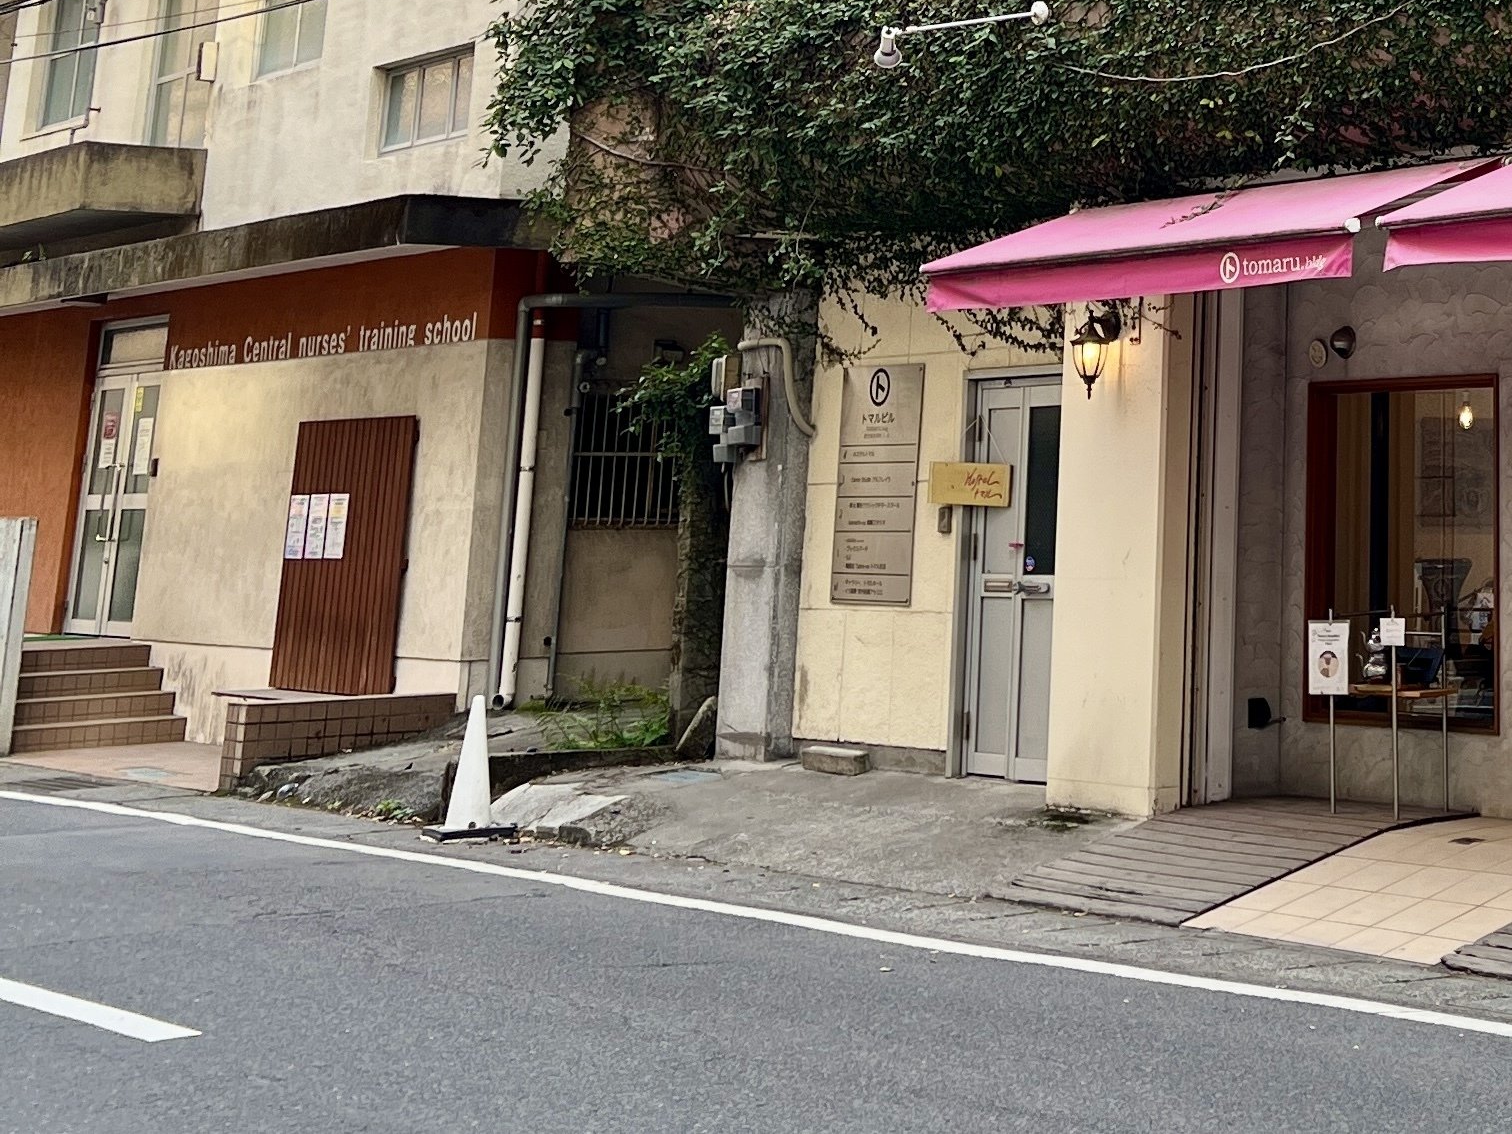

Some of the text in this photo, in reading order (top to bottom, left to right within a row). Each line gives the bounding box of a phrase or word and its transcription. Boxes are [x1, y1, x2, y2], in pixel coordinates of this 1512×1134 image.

[169, 339, 236, 370] Kagoshima
[243, 331, 292, 364] Central
[359, 319, 417, 352] training
[424, 311, 478, 345] school
[861, 411, 896, 425] トマルビル
